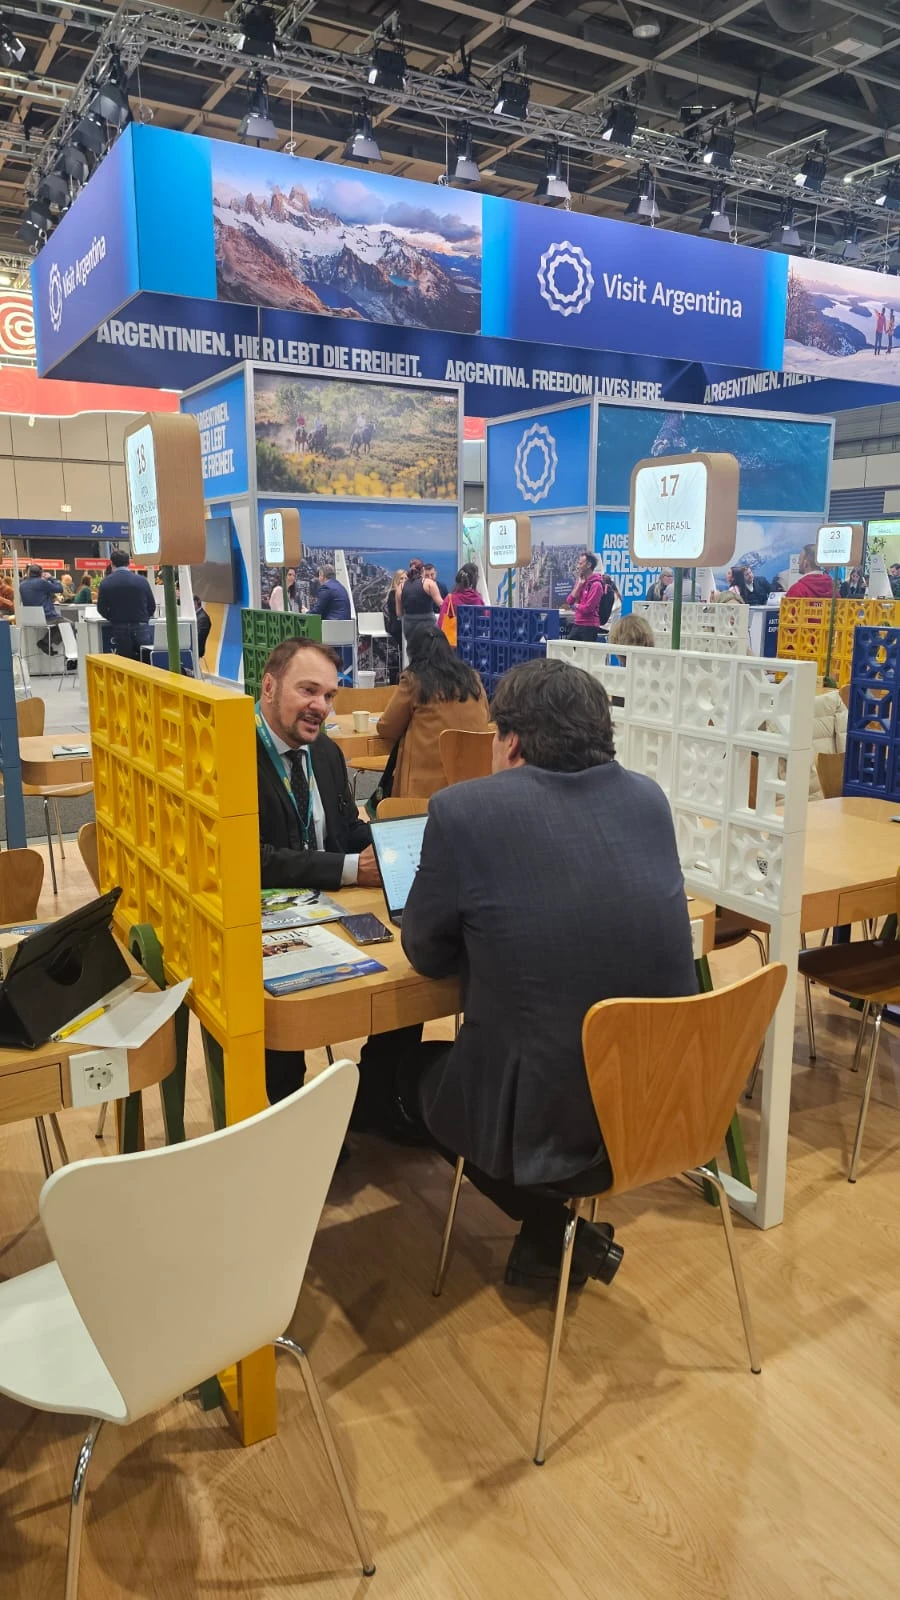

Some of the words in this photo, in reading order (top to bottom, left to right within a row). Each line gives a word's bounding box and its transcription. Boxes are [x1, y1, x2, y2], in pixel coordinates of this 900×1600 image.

[62, 265, 76, 298] Visit
[76, 235, 106, 287] Argentina
[602, 272, 647, 304] Visit
[651, 281, 742, 319] Argentina
[97, 319, 231, 357] ARGENTINIEN.
[234, 333, 275, 362] HIER
[278, 339, 320, 366] LEBT
[323, 345, 350, 370] DIE
[352, 348, 422, 378] FREIHEIT.
[445, 359, 530, 389] ARGENTINA.
[532, 369, 593, 395] FREEDOM
[595, 376, 630, 398] LIVES
[631, 381, 665, 401] HERE.
[703, 371, 781, 404] ARGENTINIEN.
[208, 448, 235, 478] FREIHEIT.
[660, 473, 680, 497] 17
[91, 524, 104, 534] 24
[499, 525, 507, 535] 21
[665, 520, 691, 531] BRASIL
[830, 530, 841, 540] 23
